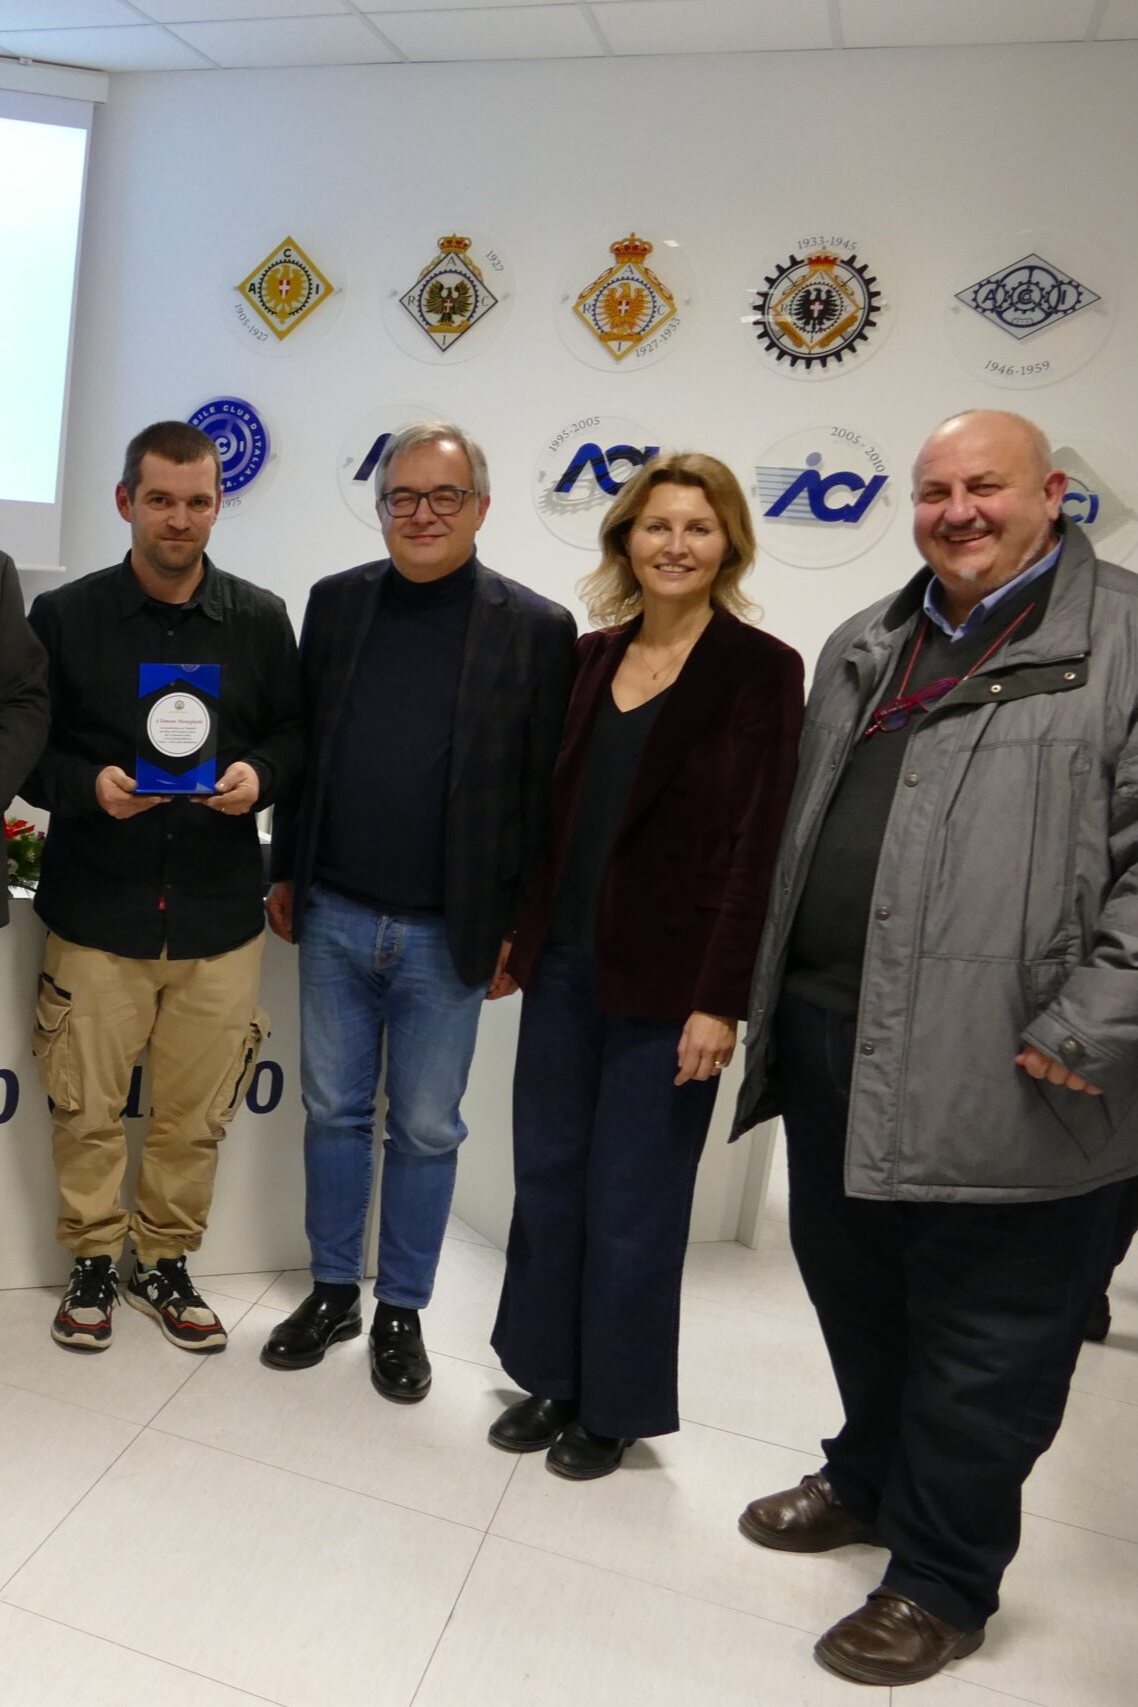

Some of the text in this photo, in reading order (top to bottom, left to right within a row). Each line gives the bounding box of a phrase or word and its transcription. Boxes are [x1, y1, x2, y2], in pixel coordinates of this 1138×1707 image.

[797, 236, 858, 251] 1933-1945
[486, 250, 504, 272] 1927
[234, 303, 270, 342] 1905-1927
[635, 317, 681, 358] 1927-1933
[984, 360, 1051, 376] 1946-1959
[223, 405, 251, 421] CLUB
[549, 416, 601, 453] 1995-2005
[763, 469, 890, 524] ACI
[1062, 491, 1100, 525] CI
